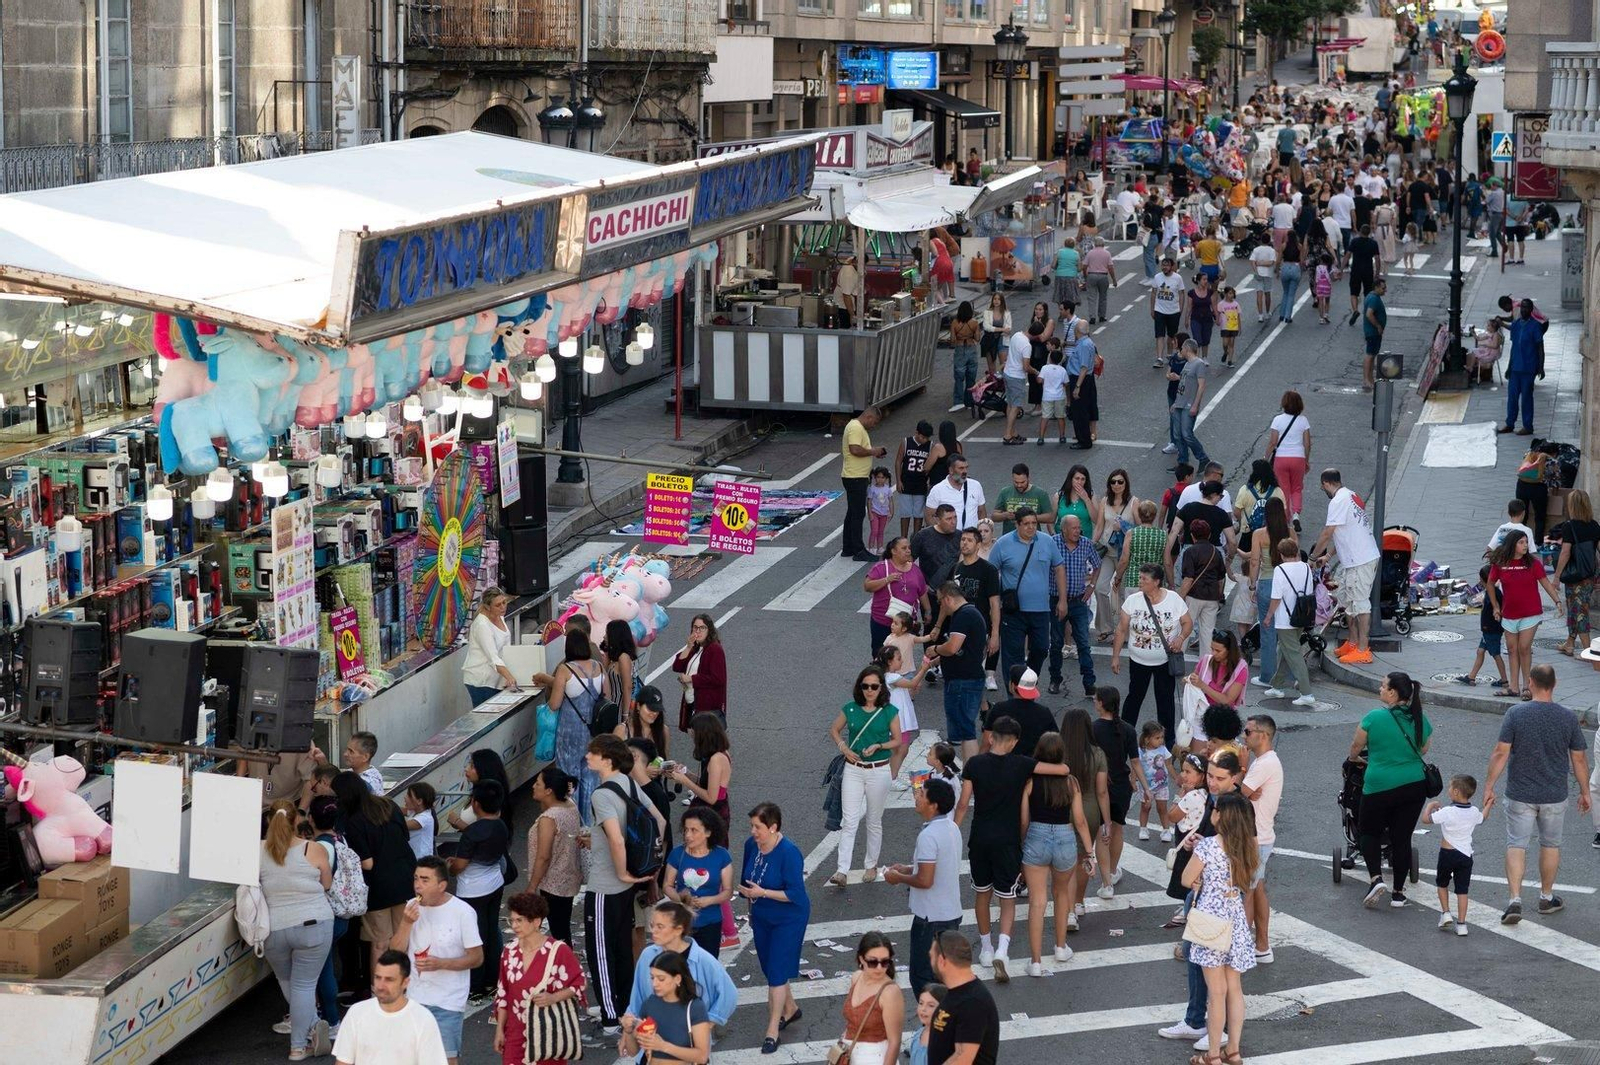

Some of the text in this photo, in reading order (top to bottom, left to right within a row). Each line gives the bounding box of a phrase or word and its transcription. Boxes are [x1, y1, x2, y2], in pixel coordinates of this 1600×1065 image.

[588, 195, 689, 244] CACHICHI
[907, 457, 925, 472] 23
[655, 475, 685, 483] PRECIO
[651, 481, 688, 490] BOLETOS
[719, 535, 753, 546] BOLETOS
[710, 541, 752, 553] DE REGALO
[52, 935, 73, 957] RONGE
